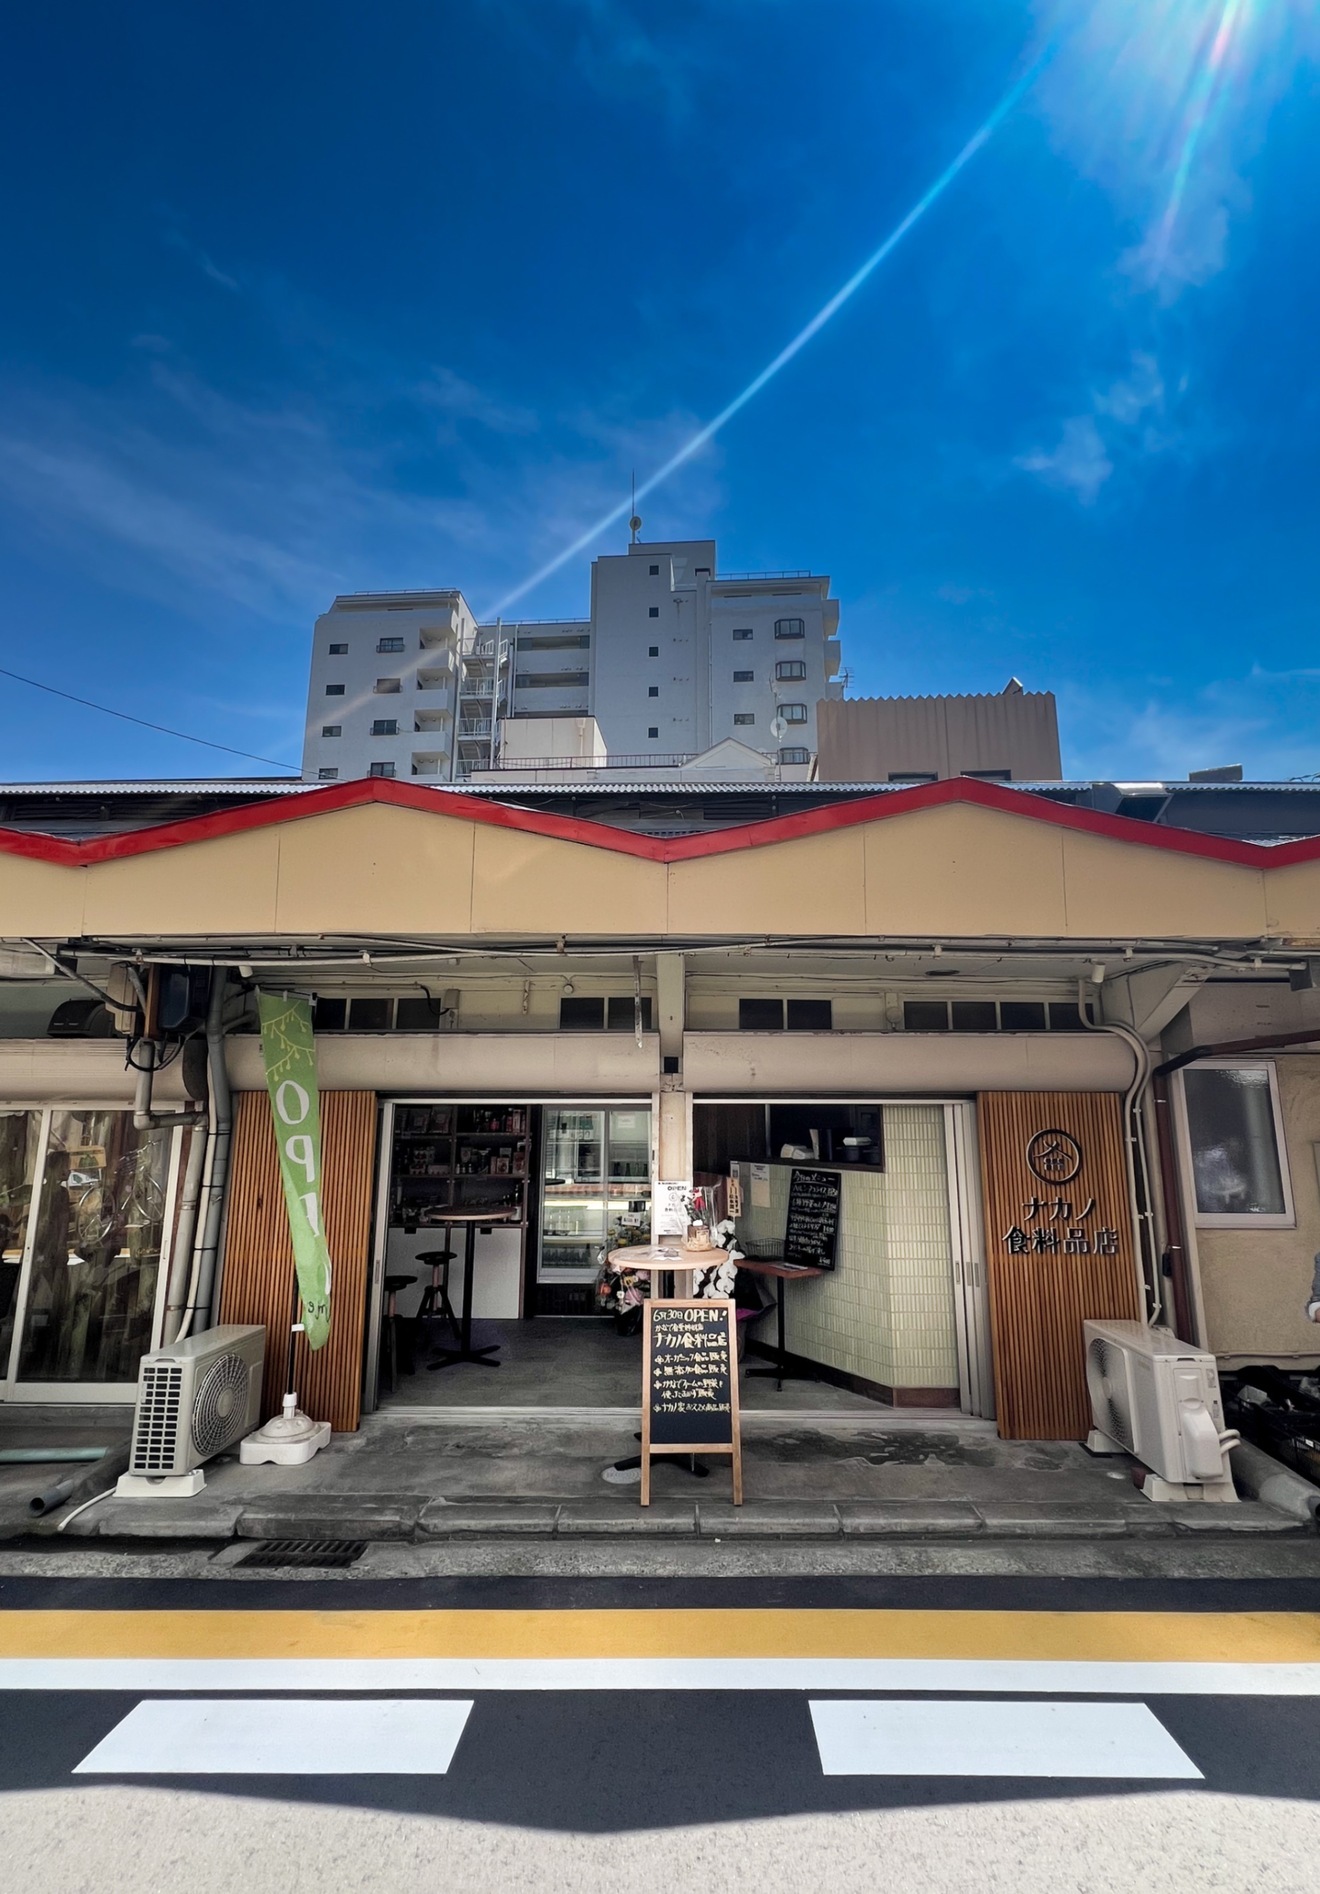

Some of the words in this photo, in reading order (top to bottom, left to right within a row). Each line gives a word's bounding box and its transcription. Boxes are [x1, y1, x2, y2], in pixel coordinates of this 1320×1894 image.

[1021, 1196, 1097, 1221] ナカノ
[1002, 1225, 1119, 1255] 食料品店
[653, 1332, 728, 1348] ナカノ食料品店
